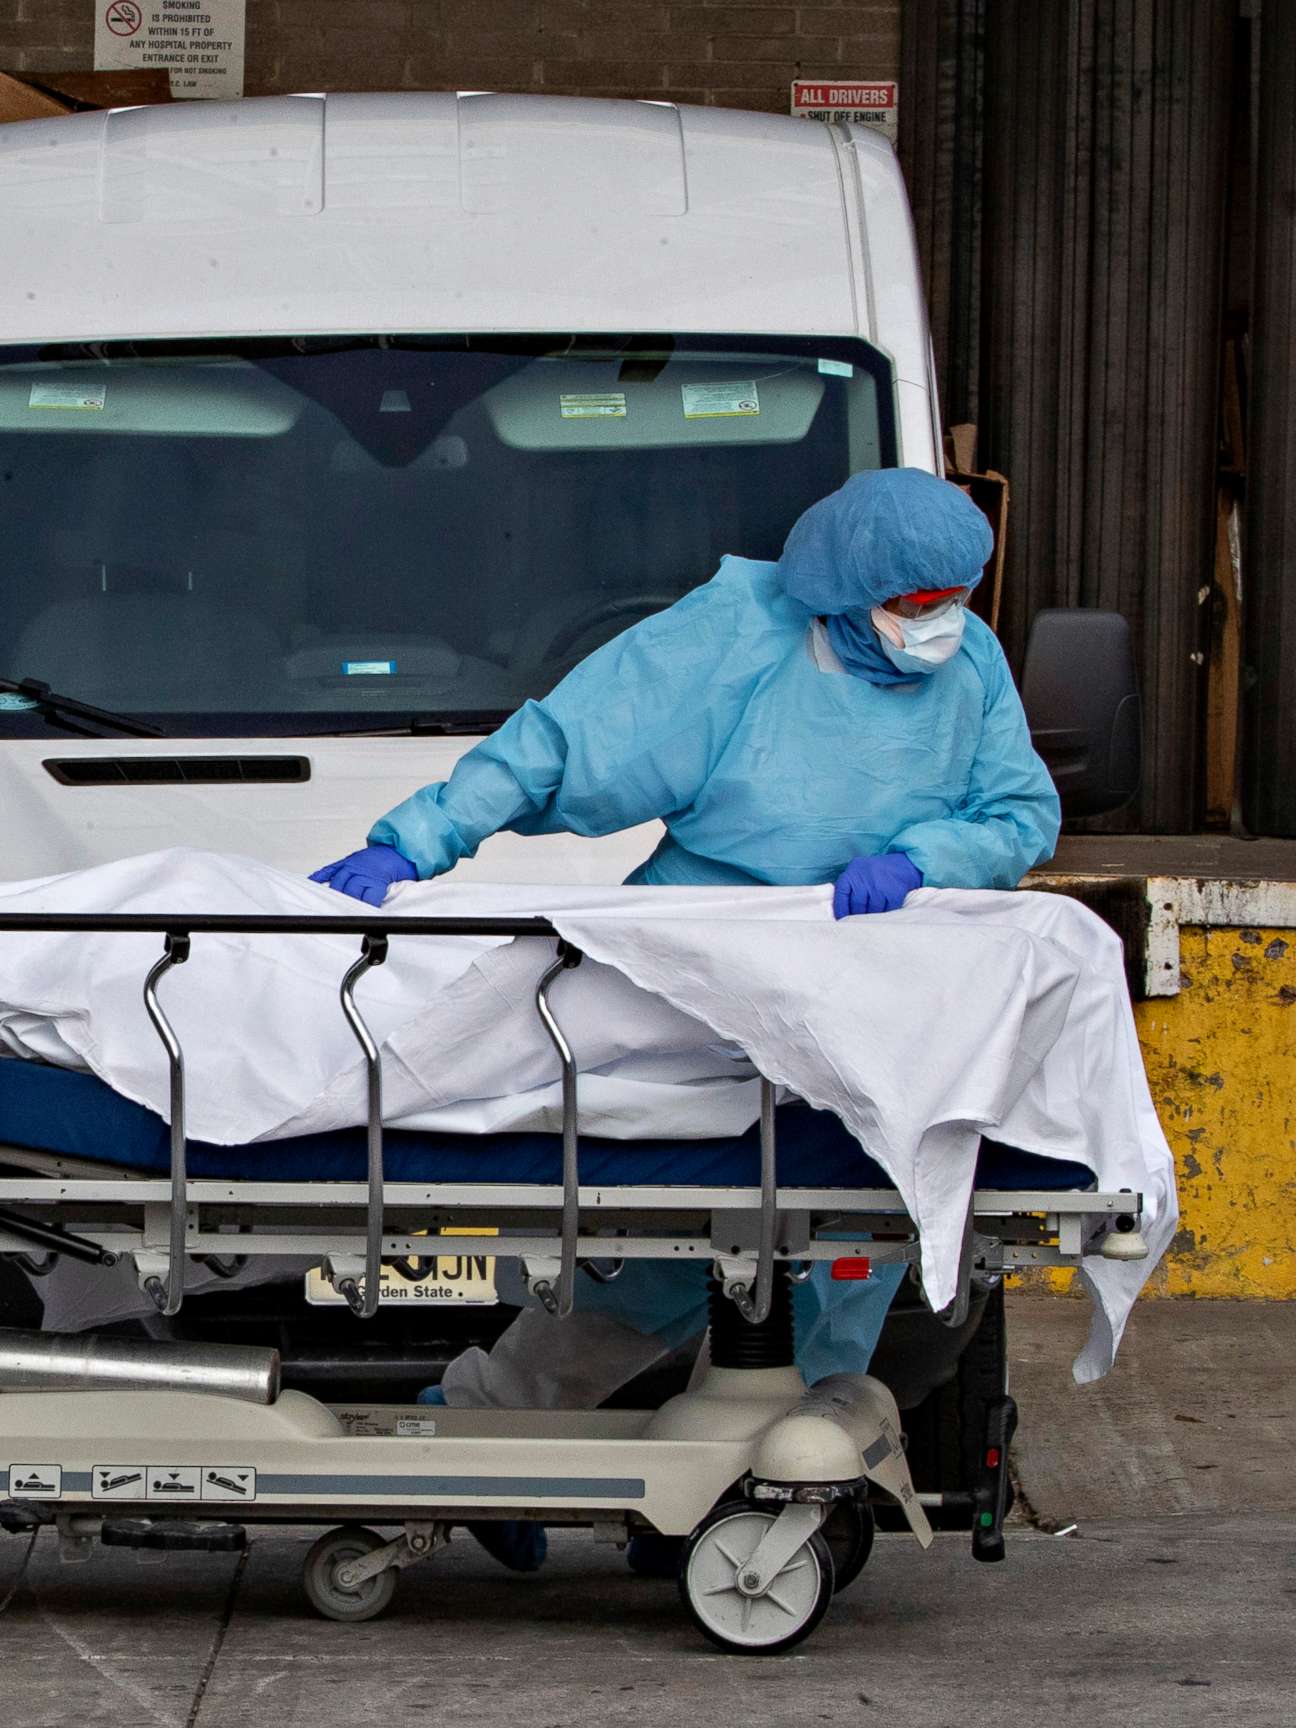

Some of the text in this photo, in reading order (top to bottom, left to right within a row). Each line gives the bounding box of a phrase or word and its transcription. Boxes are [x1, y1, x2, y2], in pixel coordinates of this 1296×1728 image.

[162, 1, 200, 10] SMOKING
[152, 14, 211, 23] IS PROHIBITED
[148, 27, 215, 36] WITHIN 15 FT OF
[129, 40, 232, 50] ANY HOSPITAL PROPERTY
[142, 53, 219, 63] ENTRANCE OR EXIT
[198, 67, 226, 75] SMOKING
[800, 89, 888, 104] ALL DRIVERS
[808, 110, 887, 122] SHUT OFF ENGINE
[414, 1285, 452, 1298] State
